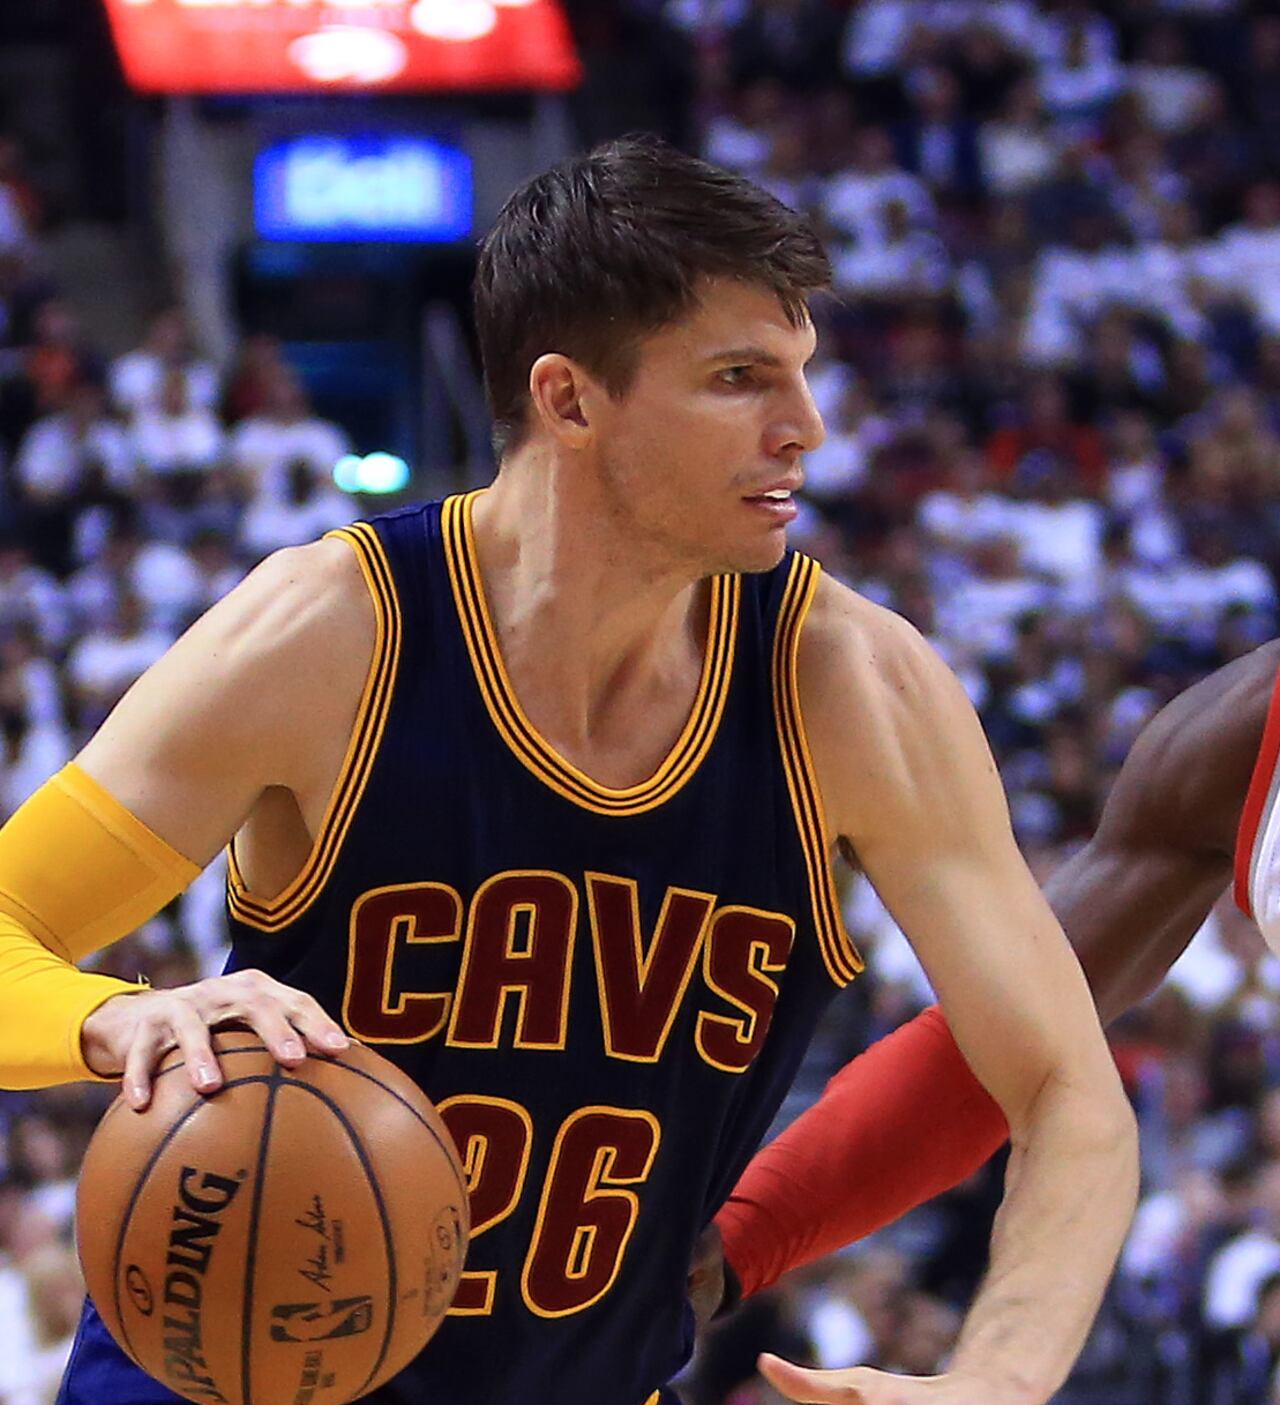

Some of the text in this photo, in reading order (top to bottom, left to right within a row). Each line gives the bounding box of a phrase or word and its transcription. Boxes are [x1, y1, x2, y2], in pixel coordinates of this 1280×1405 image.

[341, 869, 796, 1073] CAVS
[163, 1165, 241, 1405] SPALDING
[434, 1094, 661, 1318] 26
